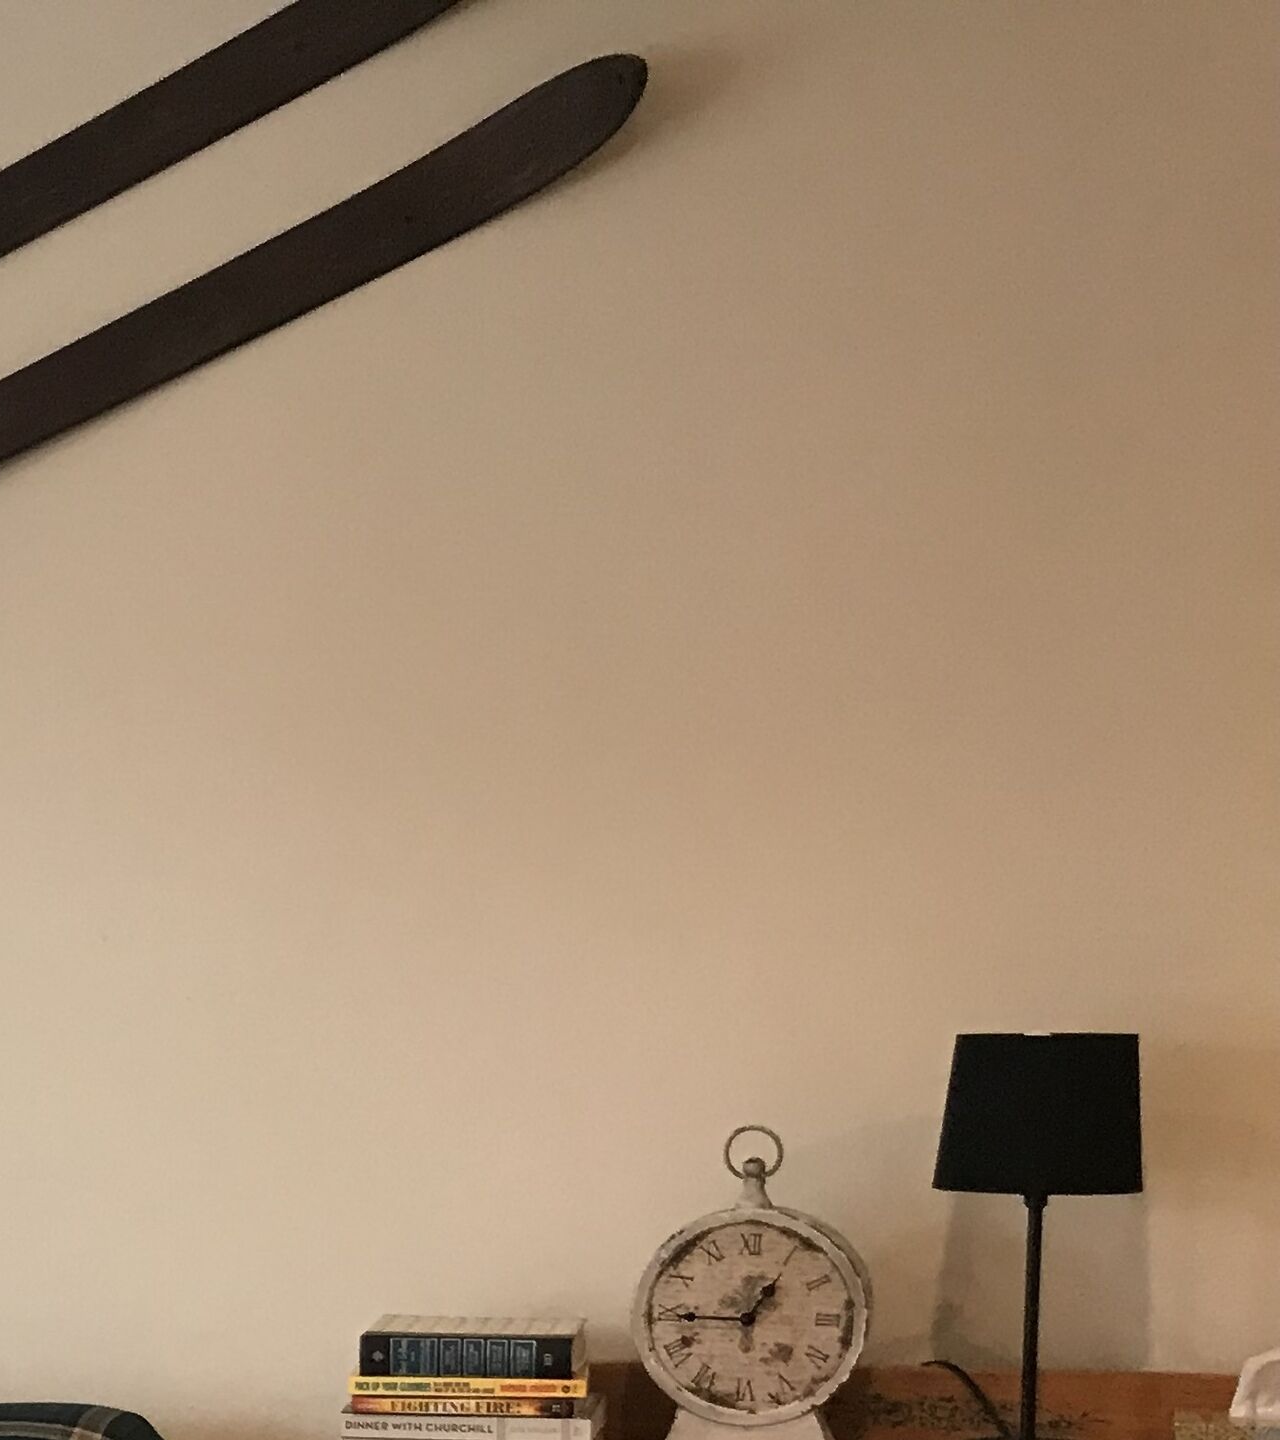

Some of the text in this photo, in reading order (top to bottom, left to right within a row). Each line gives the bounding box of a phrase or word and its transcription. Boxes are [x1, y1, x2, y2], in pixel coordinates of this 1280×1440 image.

[740, 1233, 762, 1256] XII
[700, 1240, 725, 1265] XI
[806, 1274, 832, 1291] II
[814, 1312, 840, 1326] III
[390, 1401, 470, 1414] FIGHTING
[345, 1420, 494, 1434] DINNER WITH CHURCHILL
